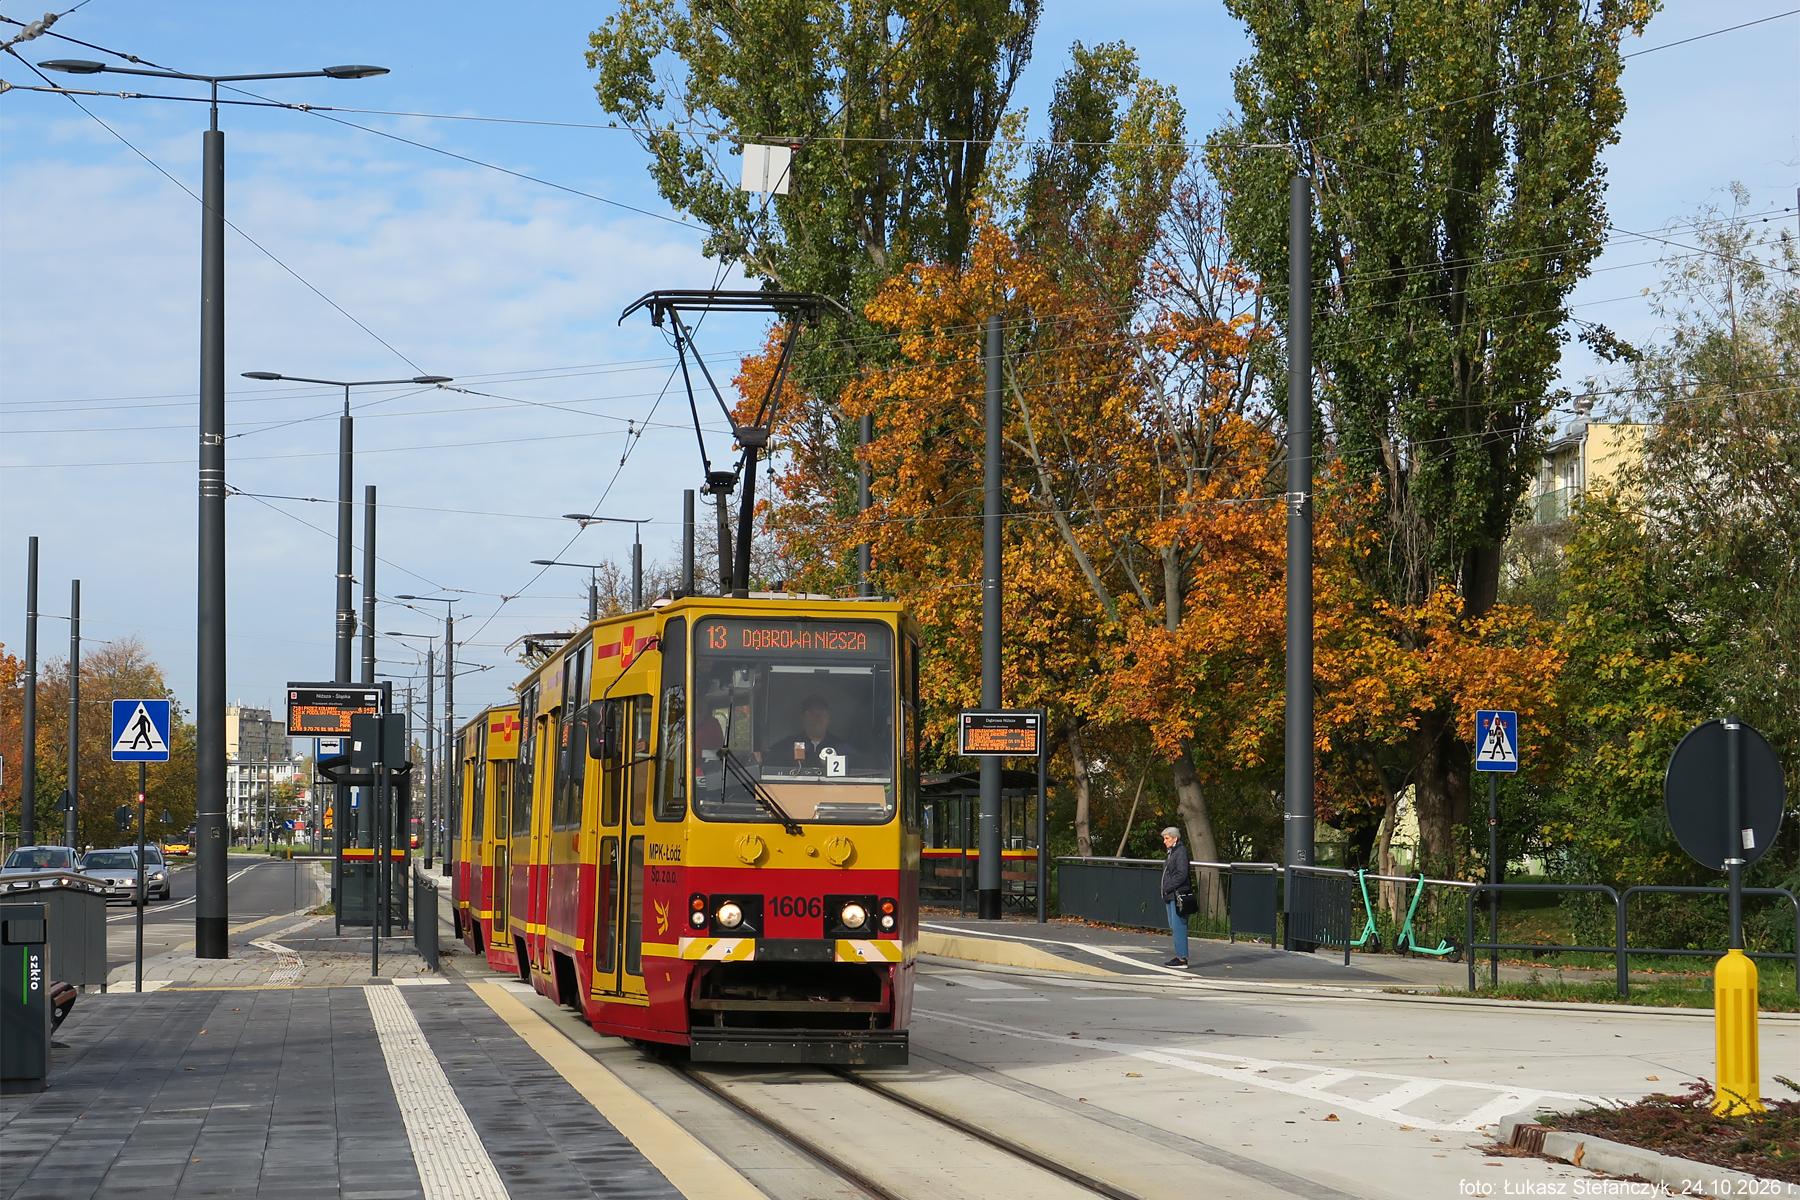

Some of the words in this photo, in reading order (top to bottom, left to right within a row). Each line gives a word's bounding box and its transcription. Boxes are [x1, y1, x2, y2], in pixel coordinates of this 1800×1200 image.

[706, 625, 728, 649] 13
[742, 629, 812, 650] DĄBROWA
[814, 630, 867, 650] NIŻSZA
[832, 761, 840, 773] 2
[649, 843, 682, 862] MPK-Łódź
[768, 896, 822, 918] 1606
[30, 955, 42, 991] szkło
